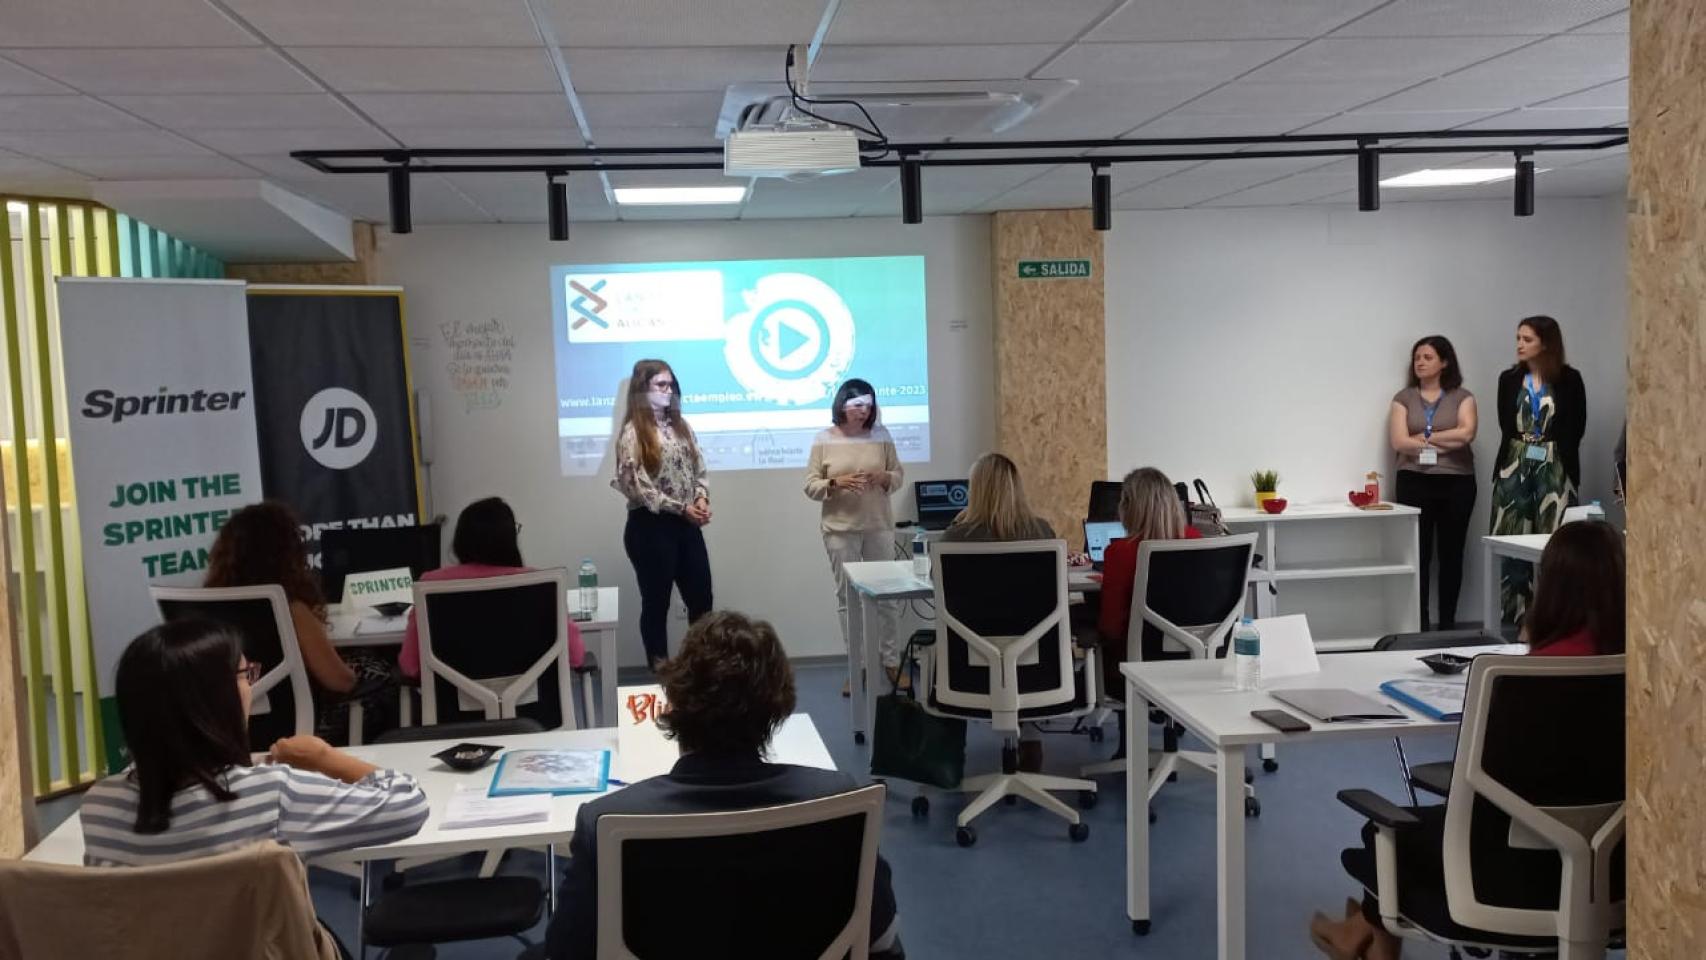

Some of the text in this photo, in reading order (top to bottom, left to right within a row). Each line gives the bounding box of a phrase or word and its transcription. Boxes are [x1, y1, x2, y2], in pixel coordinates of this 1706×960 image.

[1040, 263, 1087, 276] SALIDA
[81, 386, 246, 423] Sprinter
[312, 407, 366, 450] JD
[109, 473, 241, 508] JOIN THE
[103, 508, 241, 546] SPRINTE
[299, 520, 343, 542] ORE
[350, 575, 412, 595] SPRINTER
[626, 692, 673, 725] Bli
